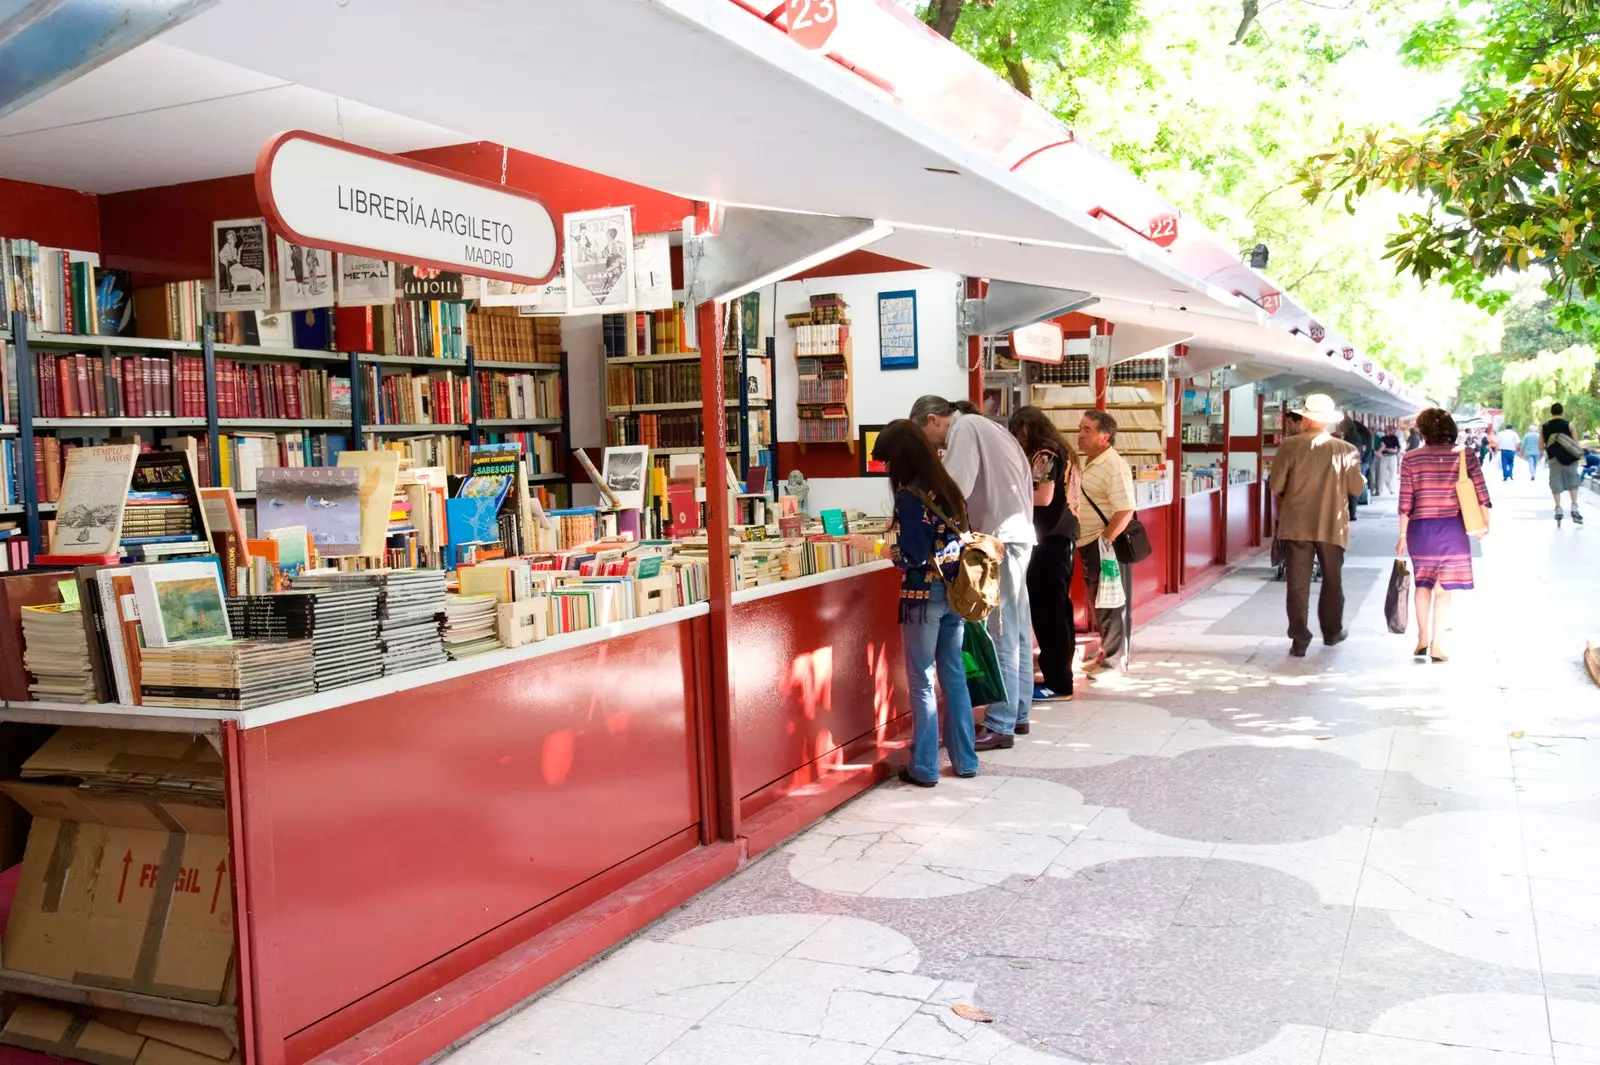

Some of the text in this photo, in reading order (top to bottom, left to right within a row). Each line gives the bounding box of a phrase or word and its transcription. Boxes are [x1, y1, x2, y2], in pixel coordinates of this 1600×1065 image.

[791, 0, 835, 30] 23
[338, 184, 513, 245] LIBRERÍA ARGILETO
[1151, 219, 1175, 238] 22
[465, 245, 513, 269] MADRID
[343, 270, 388, 280] METAL
[1263, 295, 1279, 307] 21
[1312, 329, 1324, 338] 20
[92, 447, 123, 456] TEMPLO
[104, 454, 131, 462] MAYOR
[500, 462, 516, 474] QUÉ
